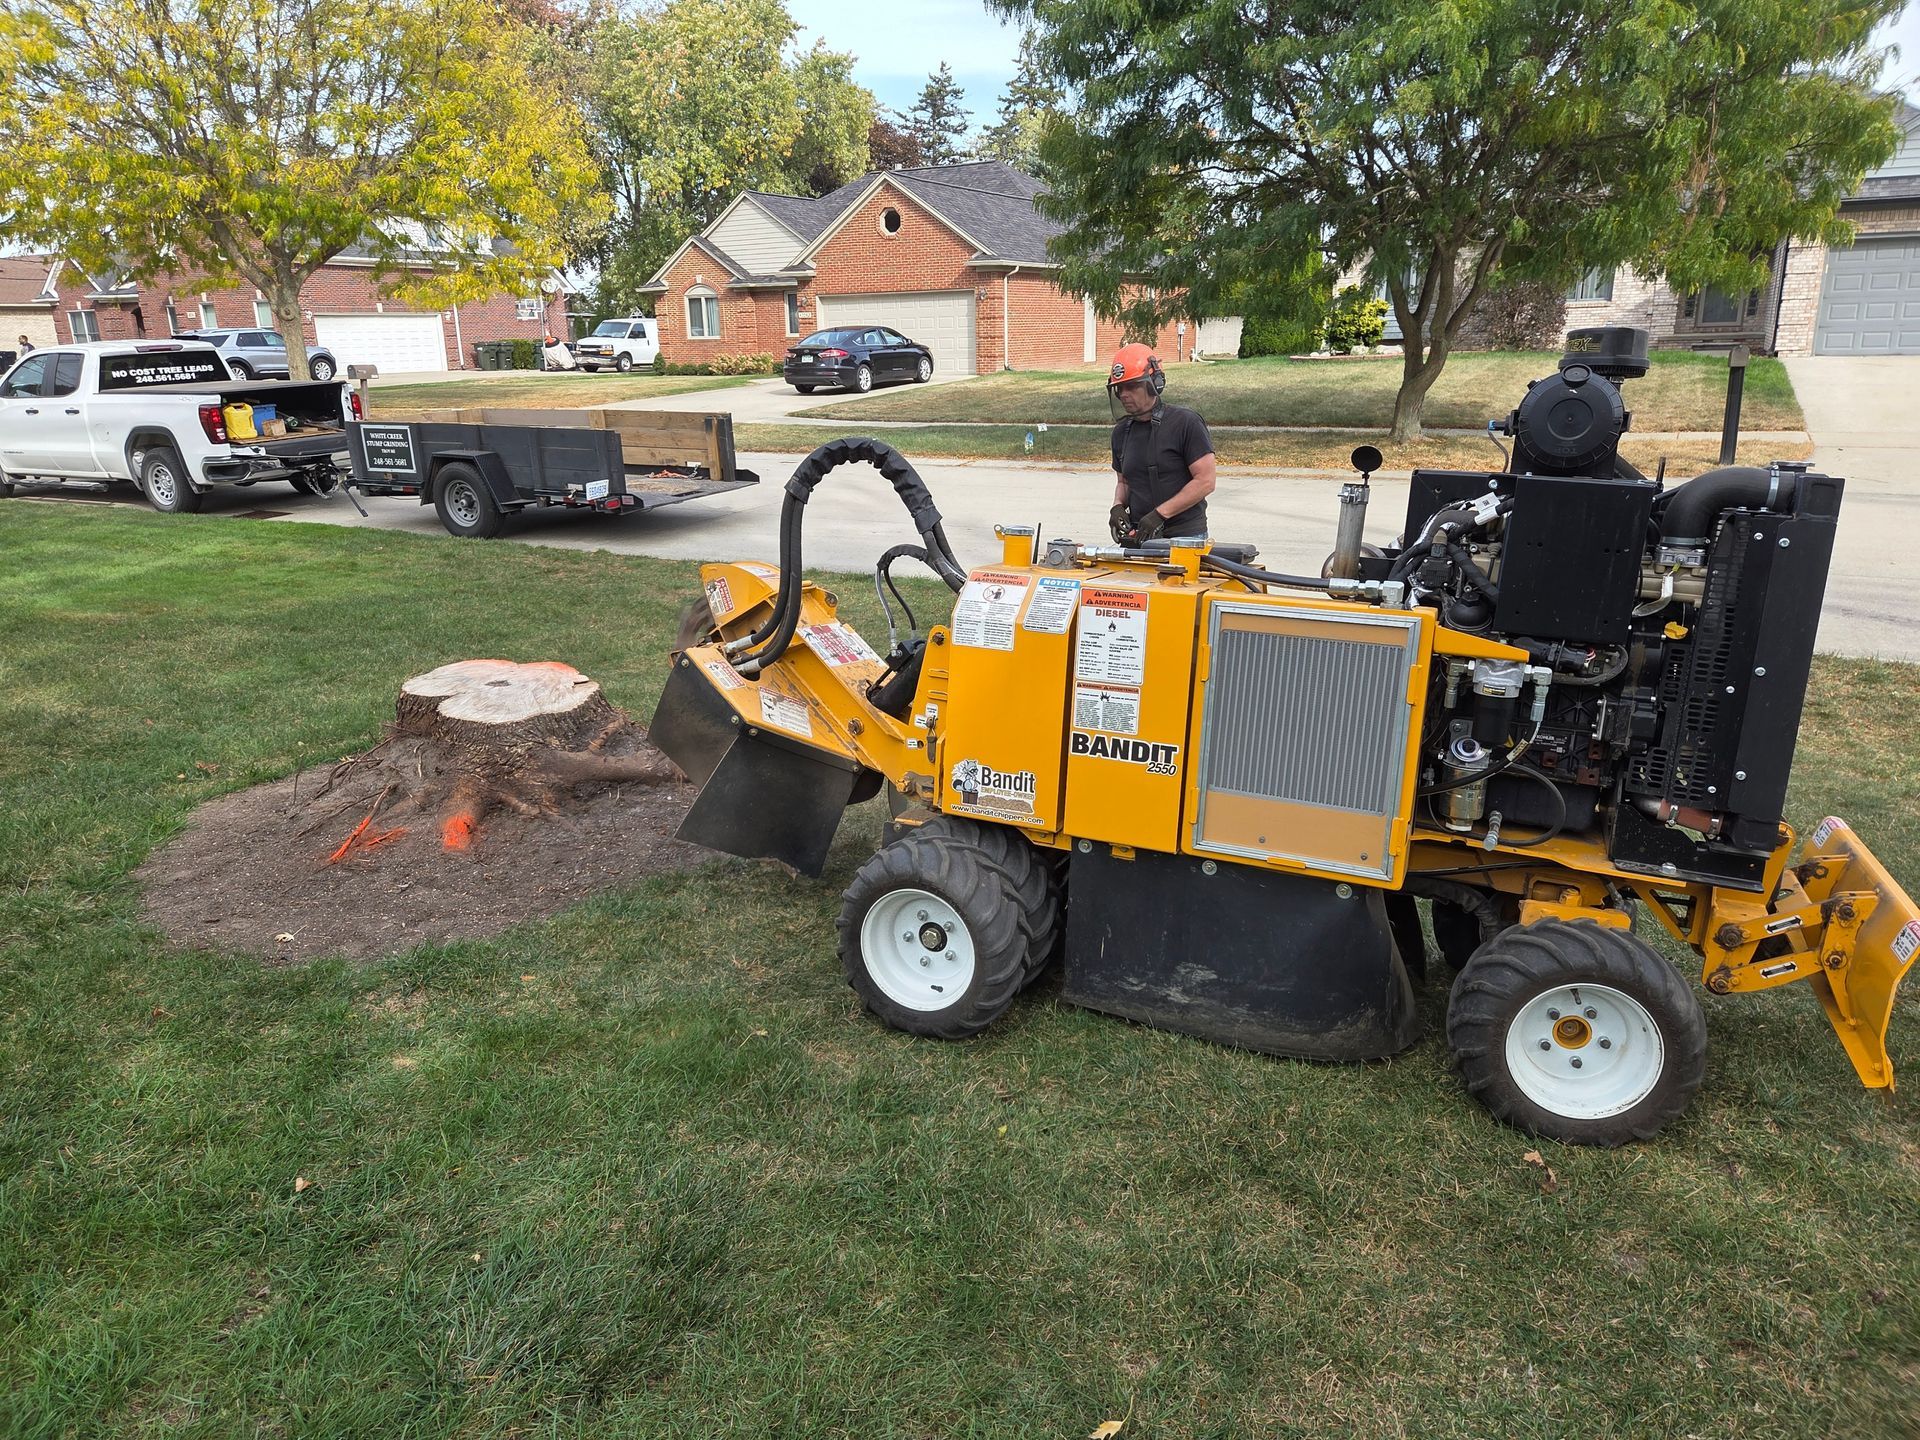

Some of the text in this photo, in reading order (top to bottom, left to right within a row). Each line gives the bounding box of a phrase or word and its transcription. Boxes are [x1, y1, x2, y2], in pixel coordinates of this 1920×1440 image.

[112, 364, 214, 378] NO COST TREE LEADS
[136, 372, 196, 383] 248.561.5681
[980, 578, 1023, 586] ADVERTENCIA
[1043, 579, 1077, 588] NOTICE
[1102, 592, 1134, 600] WARNING
[1094, 600, 1141, 609] ADVERTENCIA
[1095, 608, 1131, 619] DIESEL
[1071, 732, 1178, 764] BANDIT
[1147, 762, 1177, 775] 2550
[981, 766, 1035, 793] Bandit
[981, 786, 1034, 800] EMPLOYEE-OWNED
[951, 804, 1044, 824] www.banditchippers.com
